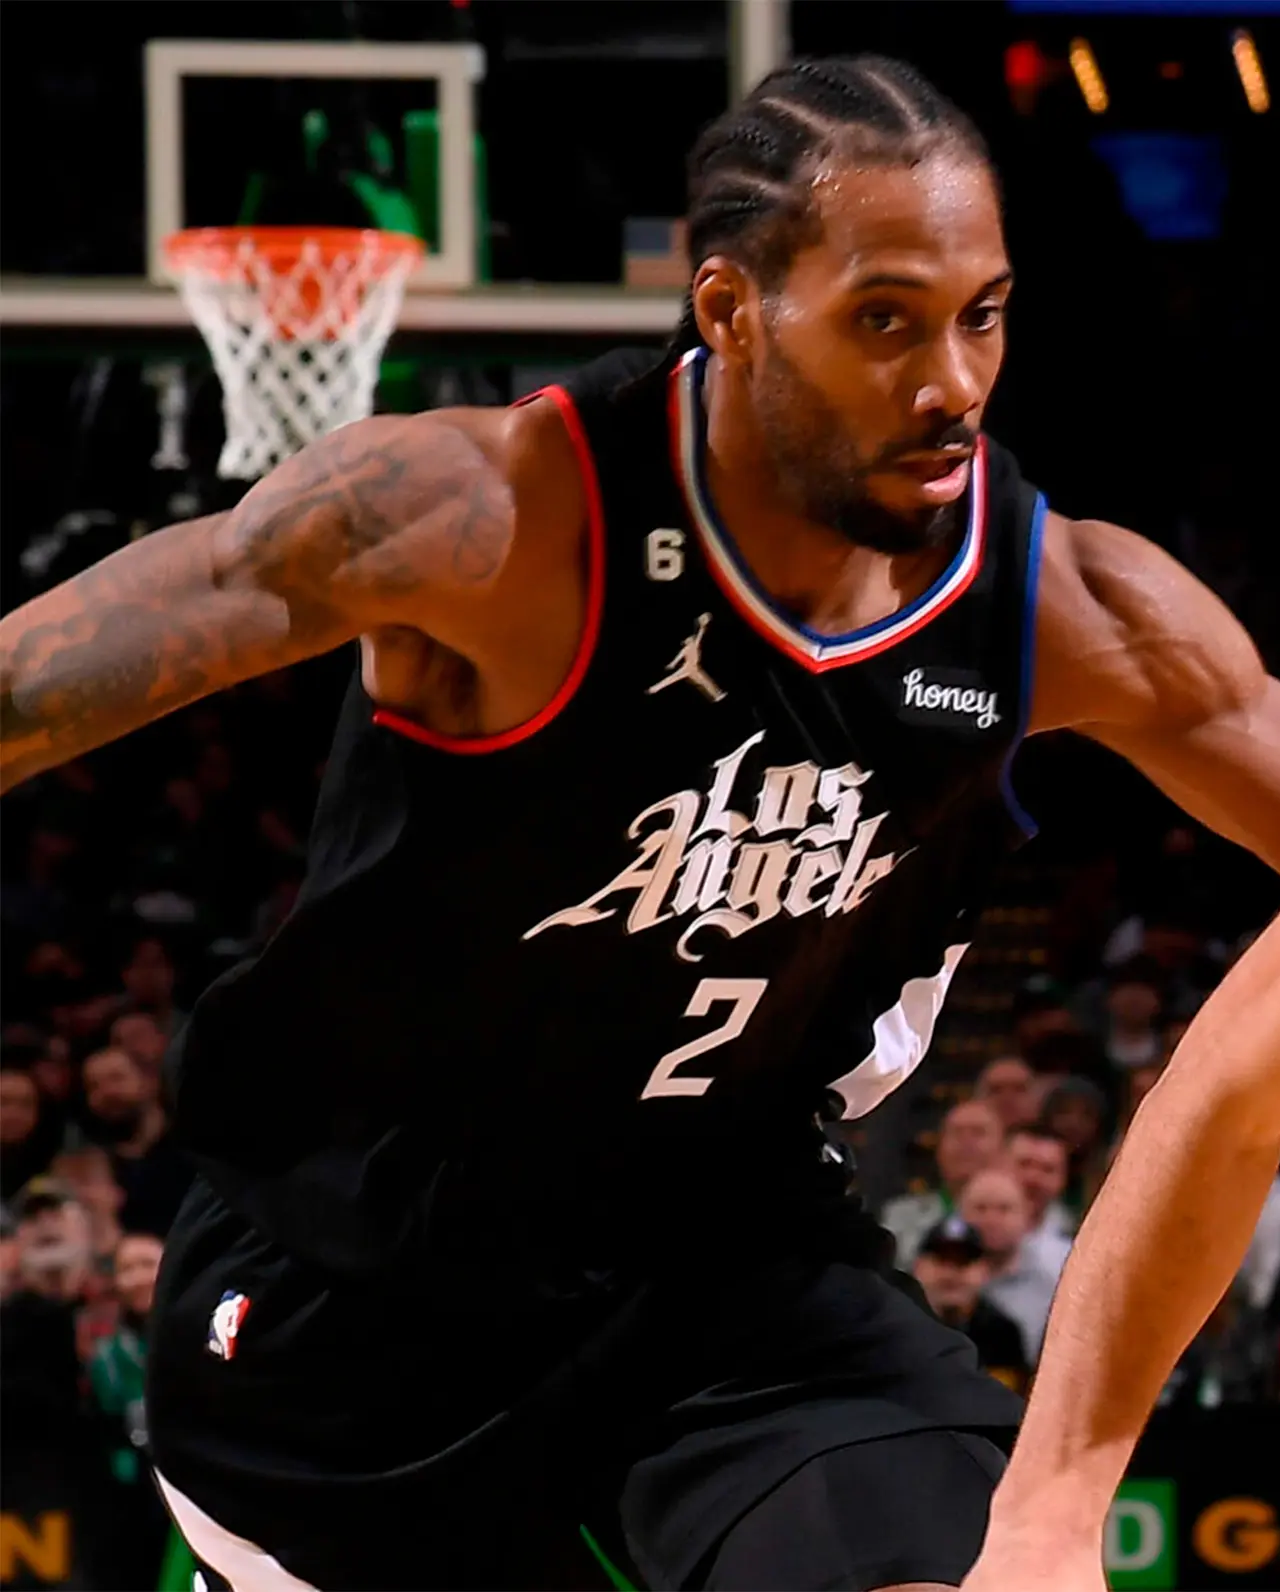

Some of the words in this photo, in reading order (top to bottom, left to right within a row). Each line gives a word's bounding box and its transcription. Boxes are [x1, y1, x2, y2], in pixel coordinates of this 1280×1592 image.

[645, 528, 685, 581] 6
[903, 667, 1001, 729] honey
[688, 729, 873, 846] Los
[519, 789, 920, 962] Angele
[639, 977, 769, 1101] 2
